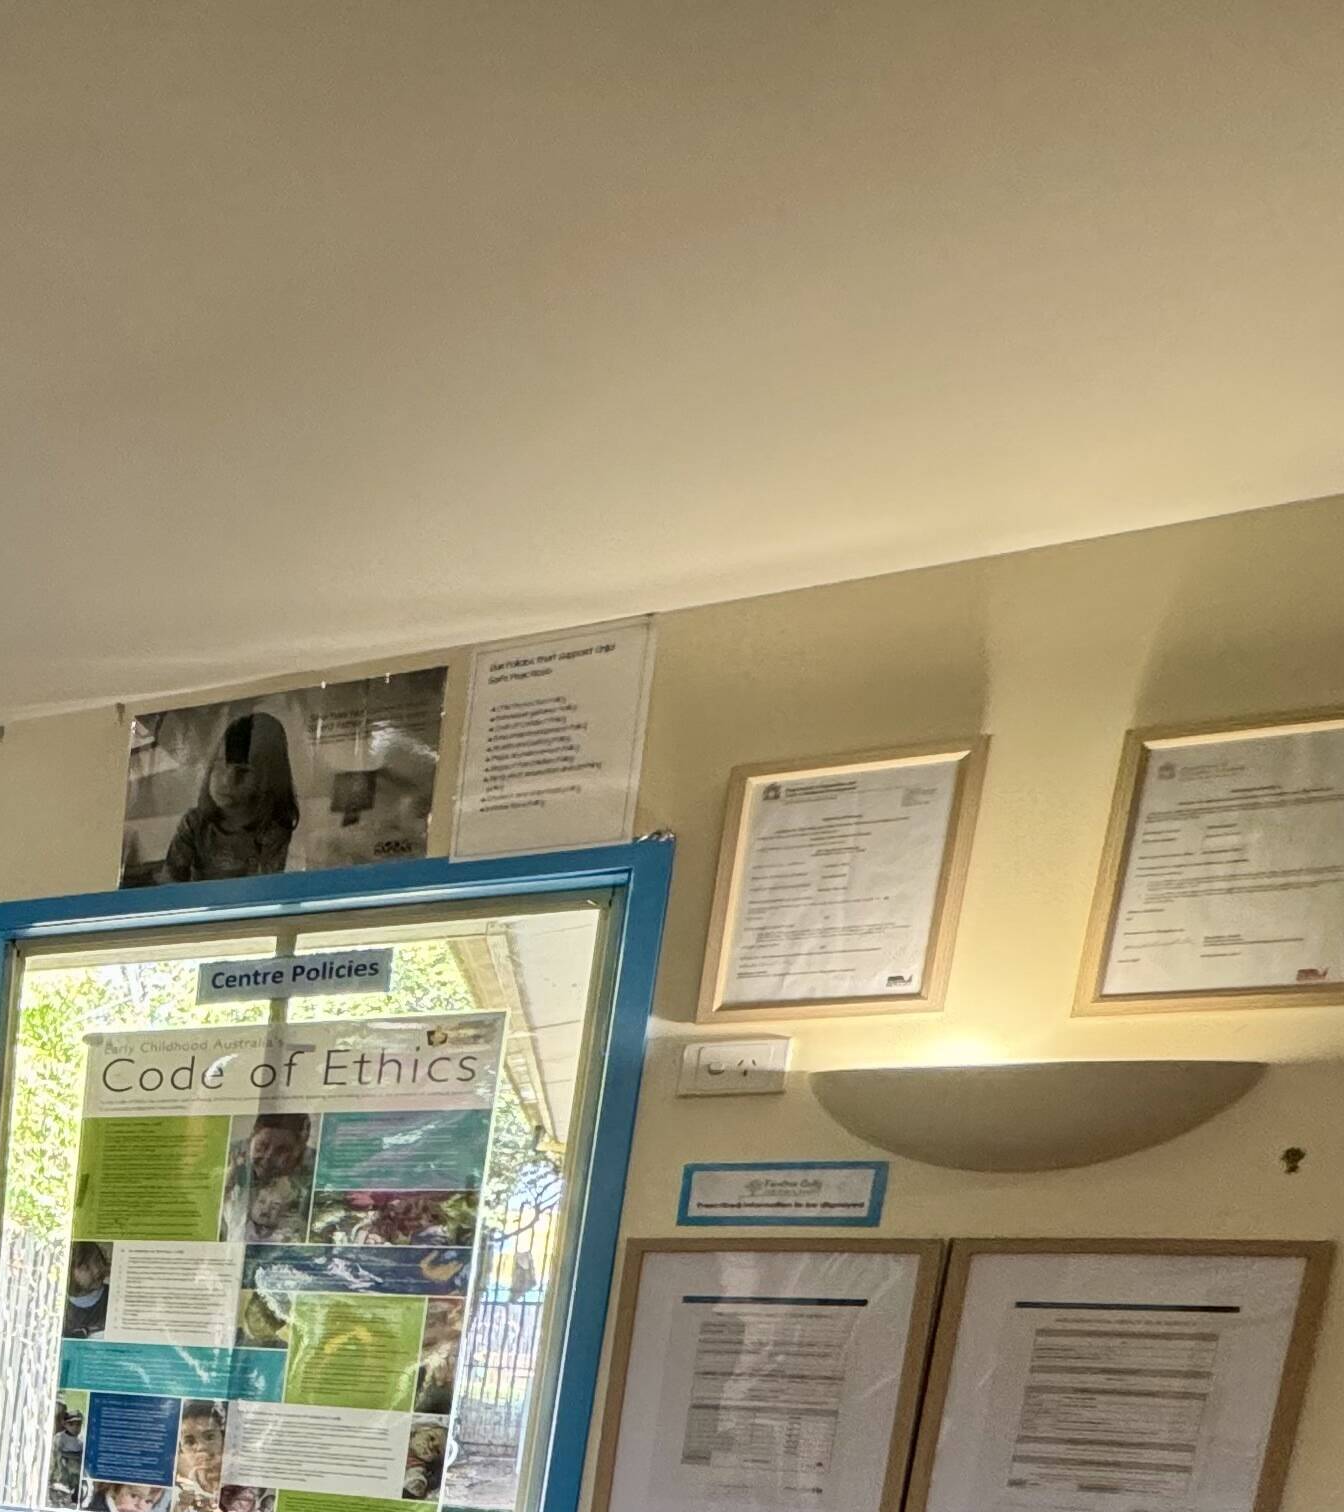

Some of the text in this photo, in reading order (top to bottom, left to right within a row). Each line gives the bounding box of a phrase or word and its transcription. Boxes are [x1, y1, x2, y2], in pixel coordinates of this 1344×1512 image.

[211, 959, 380, 991] Centre Policies
[140, 1037, 208, 1054] Childhood
[103, 1047, 478, 1092] Code of Ethics
